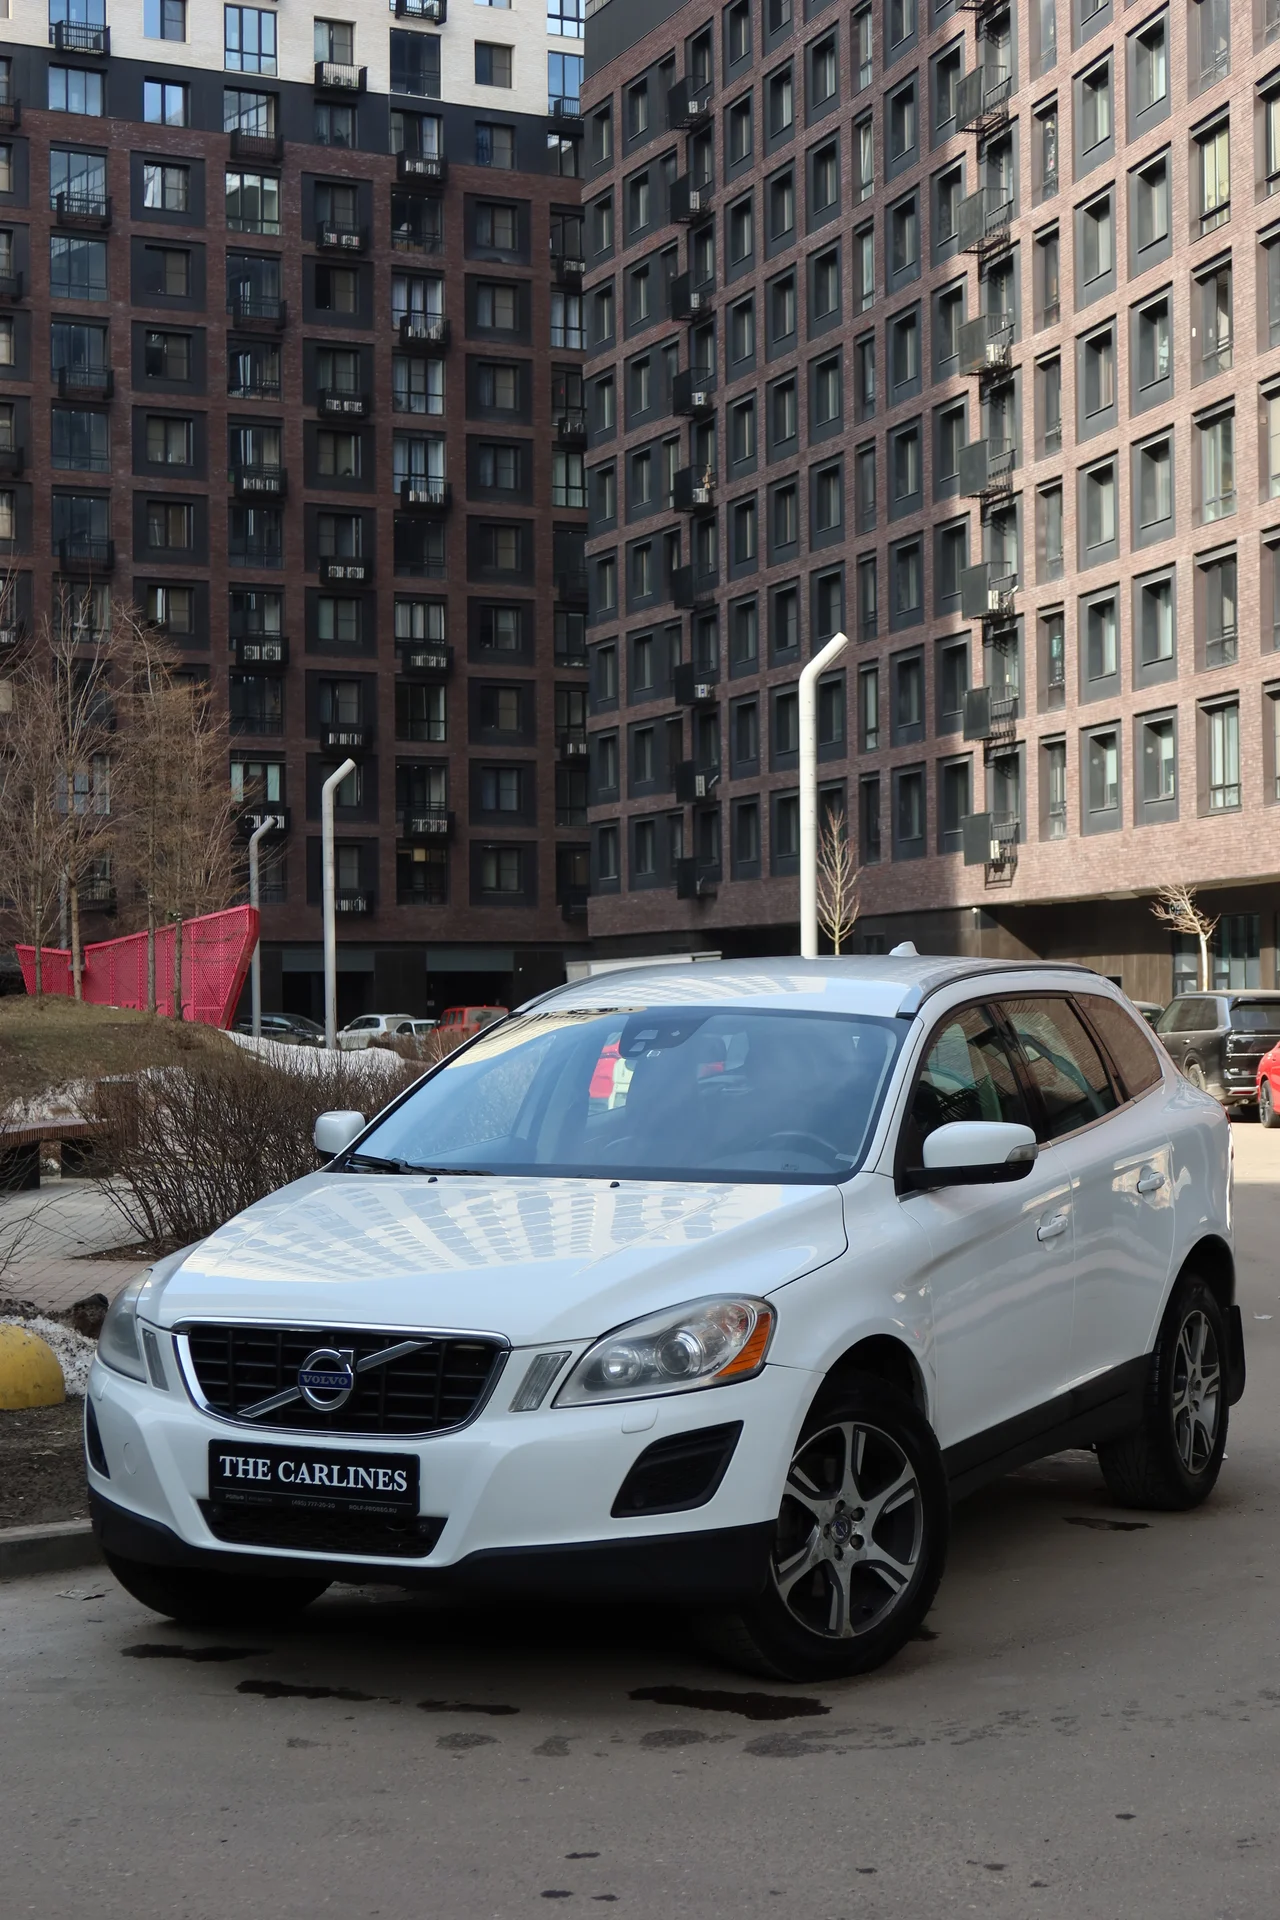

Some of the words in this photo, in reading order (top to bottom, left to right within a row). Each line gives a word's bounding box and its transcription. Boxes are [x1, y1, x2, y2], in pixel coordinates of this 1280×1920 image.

[302, 1374, 348, 1385] VOLVO
[219, 1455, 271, 1480] THE
[277, 1461, 408, 1492] CARLINES
